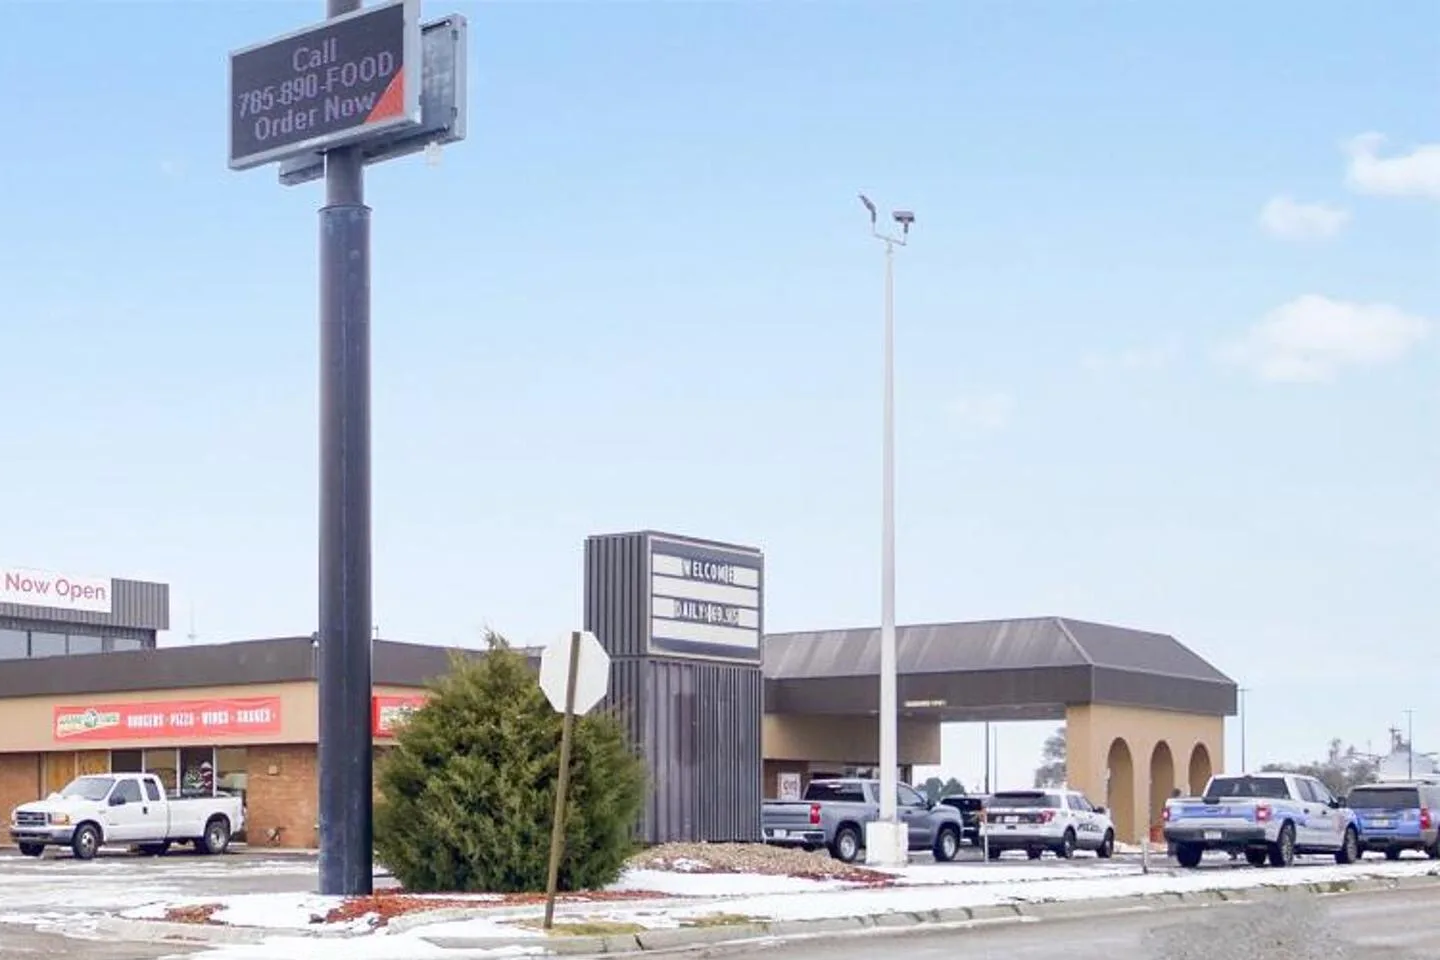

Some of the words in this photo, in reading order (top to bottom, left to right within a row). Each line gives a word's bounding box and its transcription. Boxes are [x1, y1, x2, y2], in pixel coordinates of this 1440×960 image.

[292, 37, 337, 72] Call
[237, 51, 394, 119] 785-890-FOOD
[254, 108, 317, 140] Order
[324, 91, 376, 122] Now
[5, 573, 51, 595] Now
[55, 579, 106, 602] Open
[681, 560, 736, 583] WELCOME
